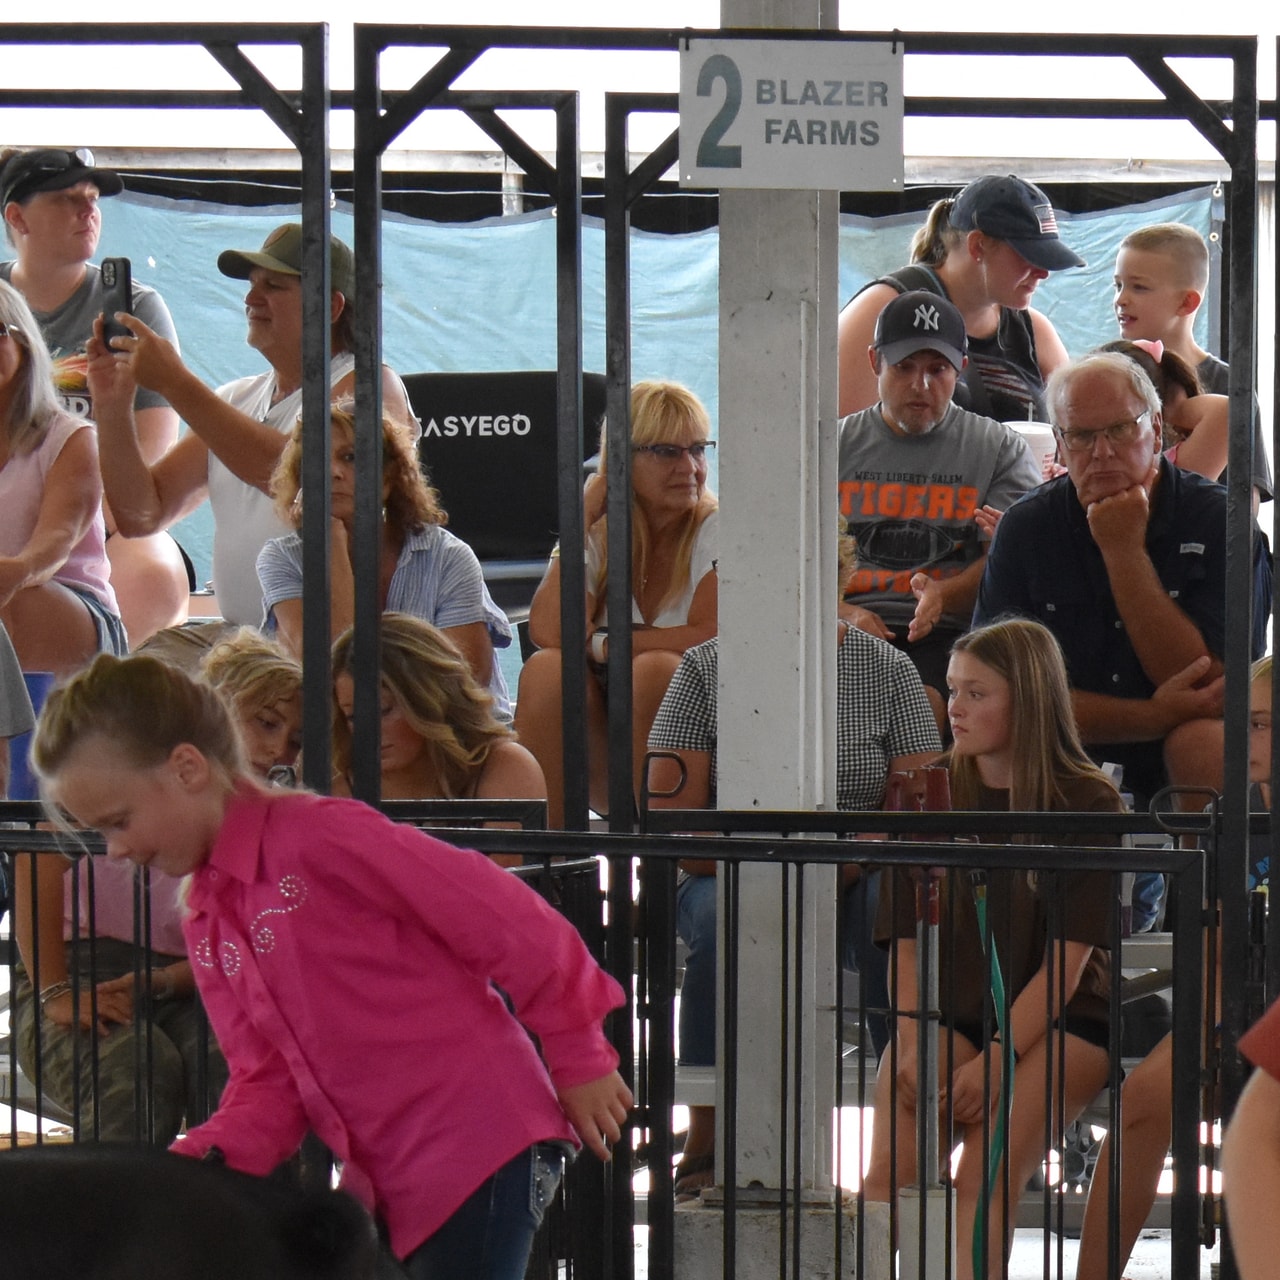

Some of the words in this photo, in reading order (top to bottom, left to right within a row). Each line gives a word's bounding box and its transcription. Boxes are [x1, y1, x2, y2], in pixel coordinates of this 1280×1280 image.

[756, 79, 888, 107] BLAZER
[696, 54, 742, 168] 2
[765, 119, 880, 146] FARMS
[415, 413, 532, 438] ASYEGO
[855, 471, 881, 481] WEST
[838, 481, 979, 521] TIGERS
